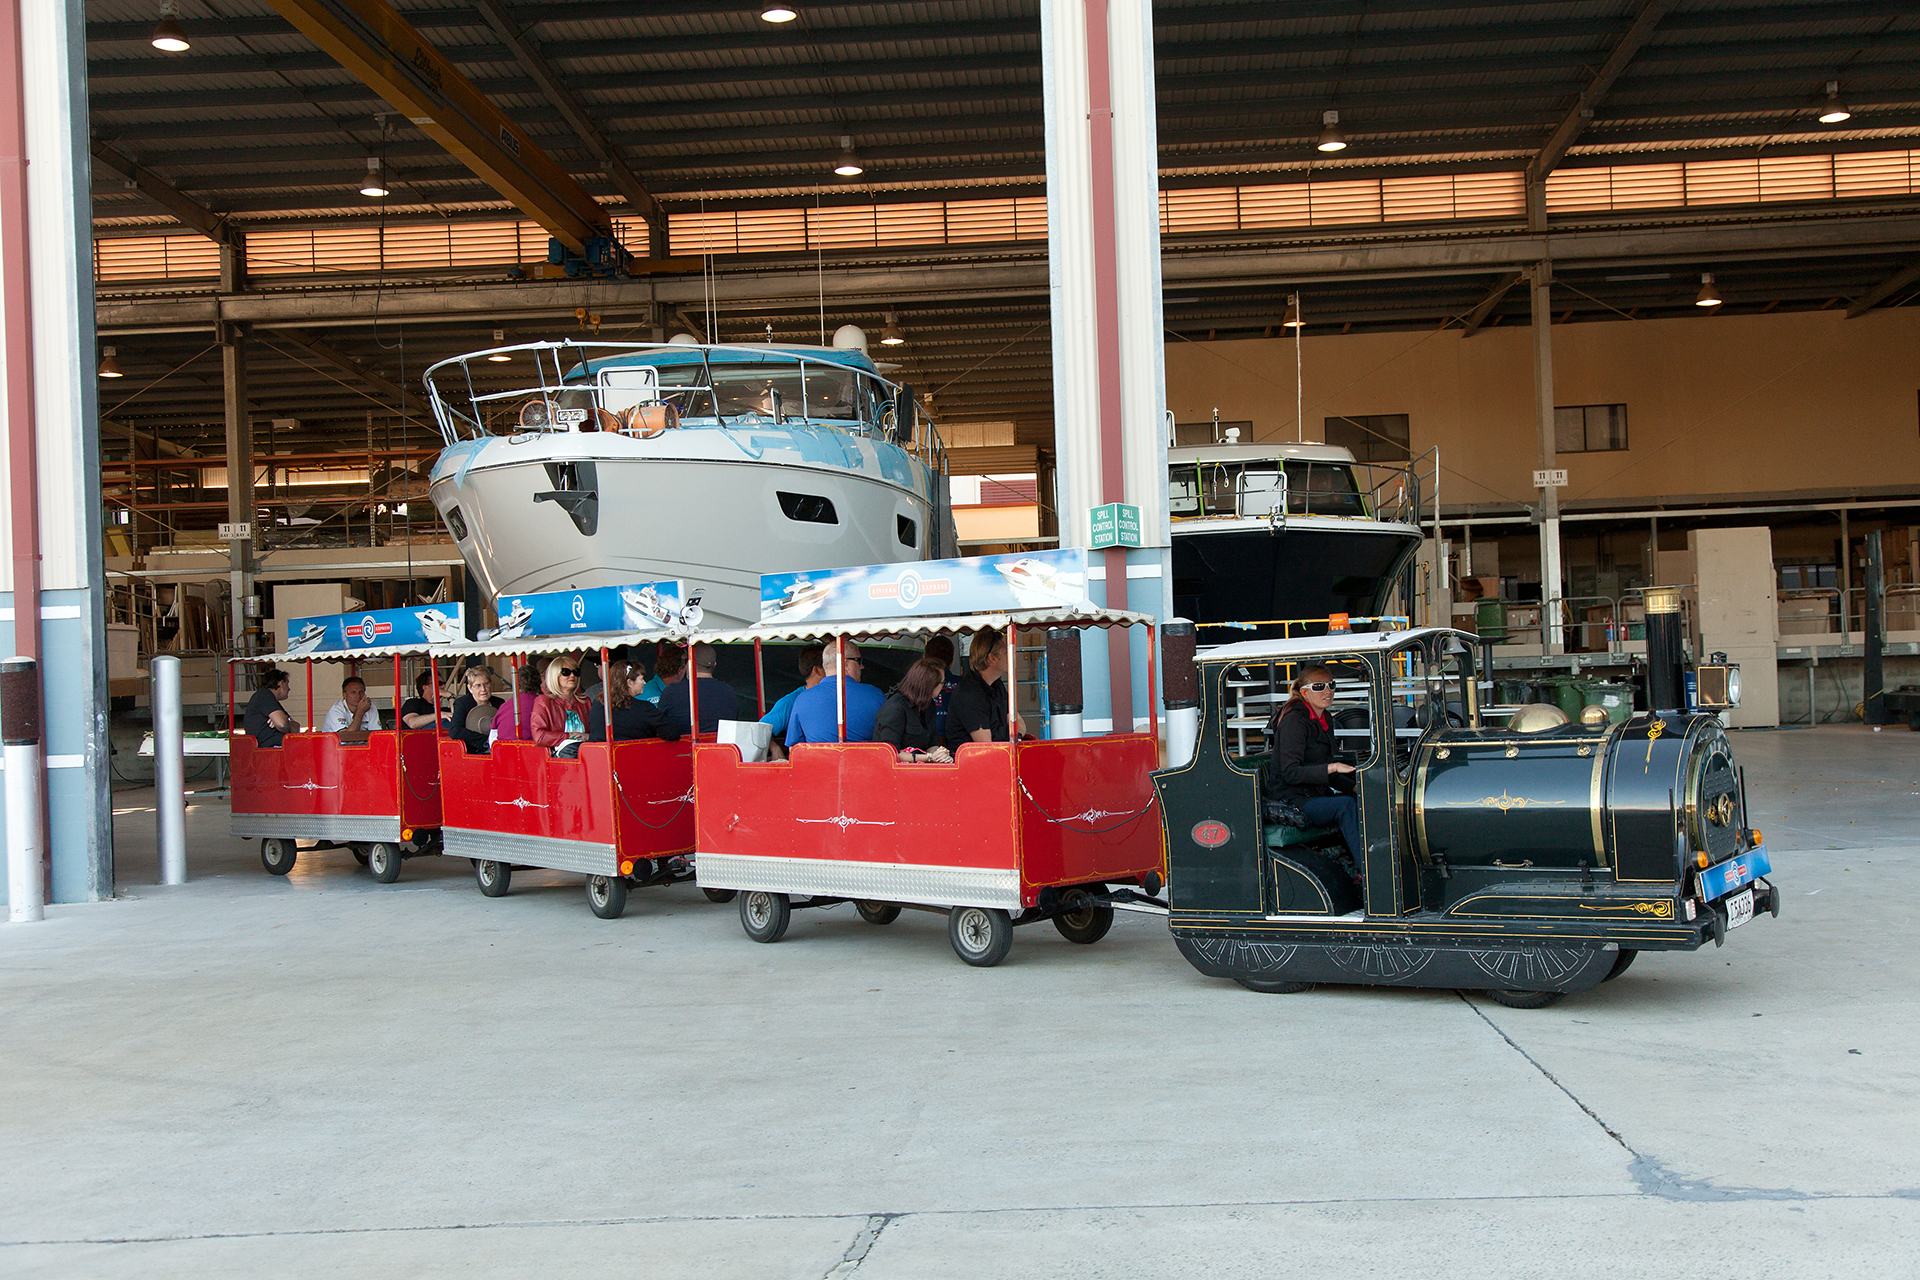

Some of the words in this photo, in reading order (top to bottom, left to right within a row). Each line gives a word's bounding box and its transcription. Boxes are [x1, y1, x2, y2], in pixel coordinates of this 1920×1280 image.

[501, 126, 520, 157] ABUS
[1096, 510, 1110, 520] SPILL
[1122, 508, 1134, 518] SPILL
[1092, 520, 1114, 532] CONTROL
[1118, 520, 1138, 531] CONTROL
[1094, 532, 1113, 544] STATION
[1120, 532, 1138, 542] STATION
[1201, 828, 1218, 840] 47
